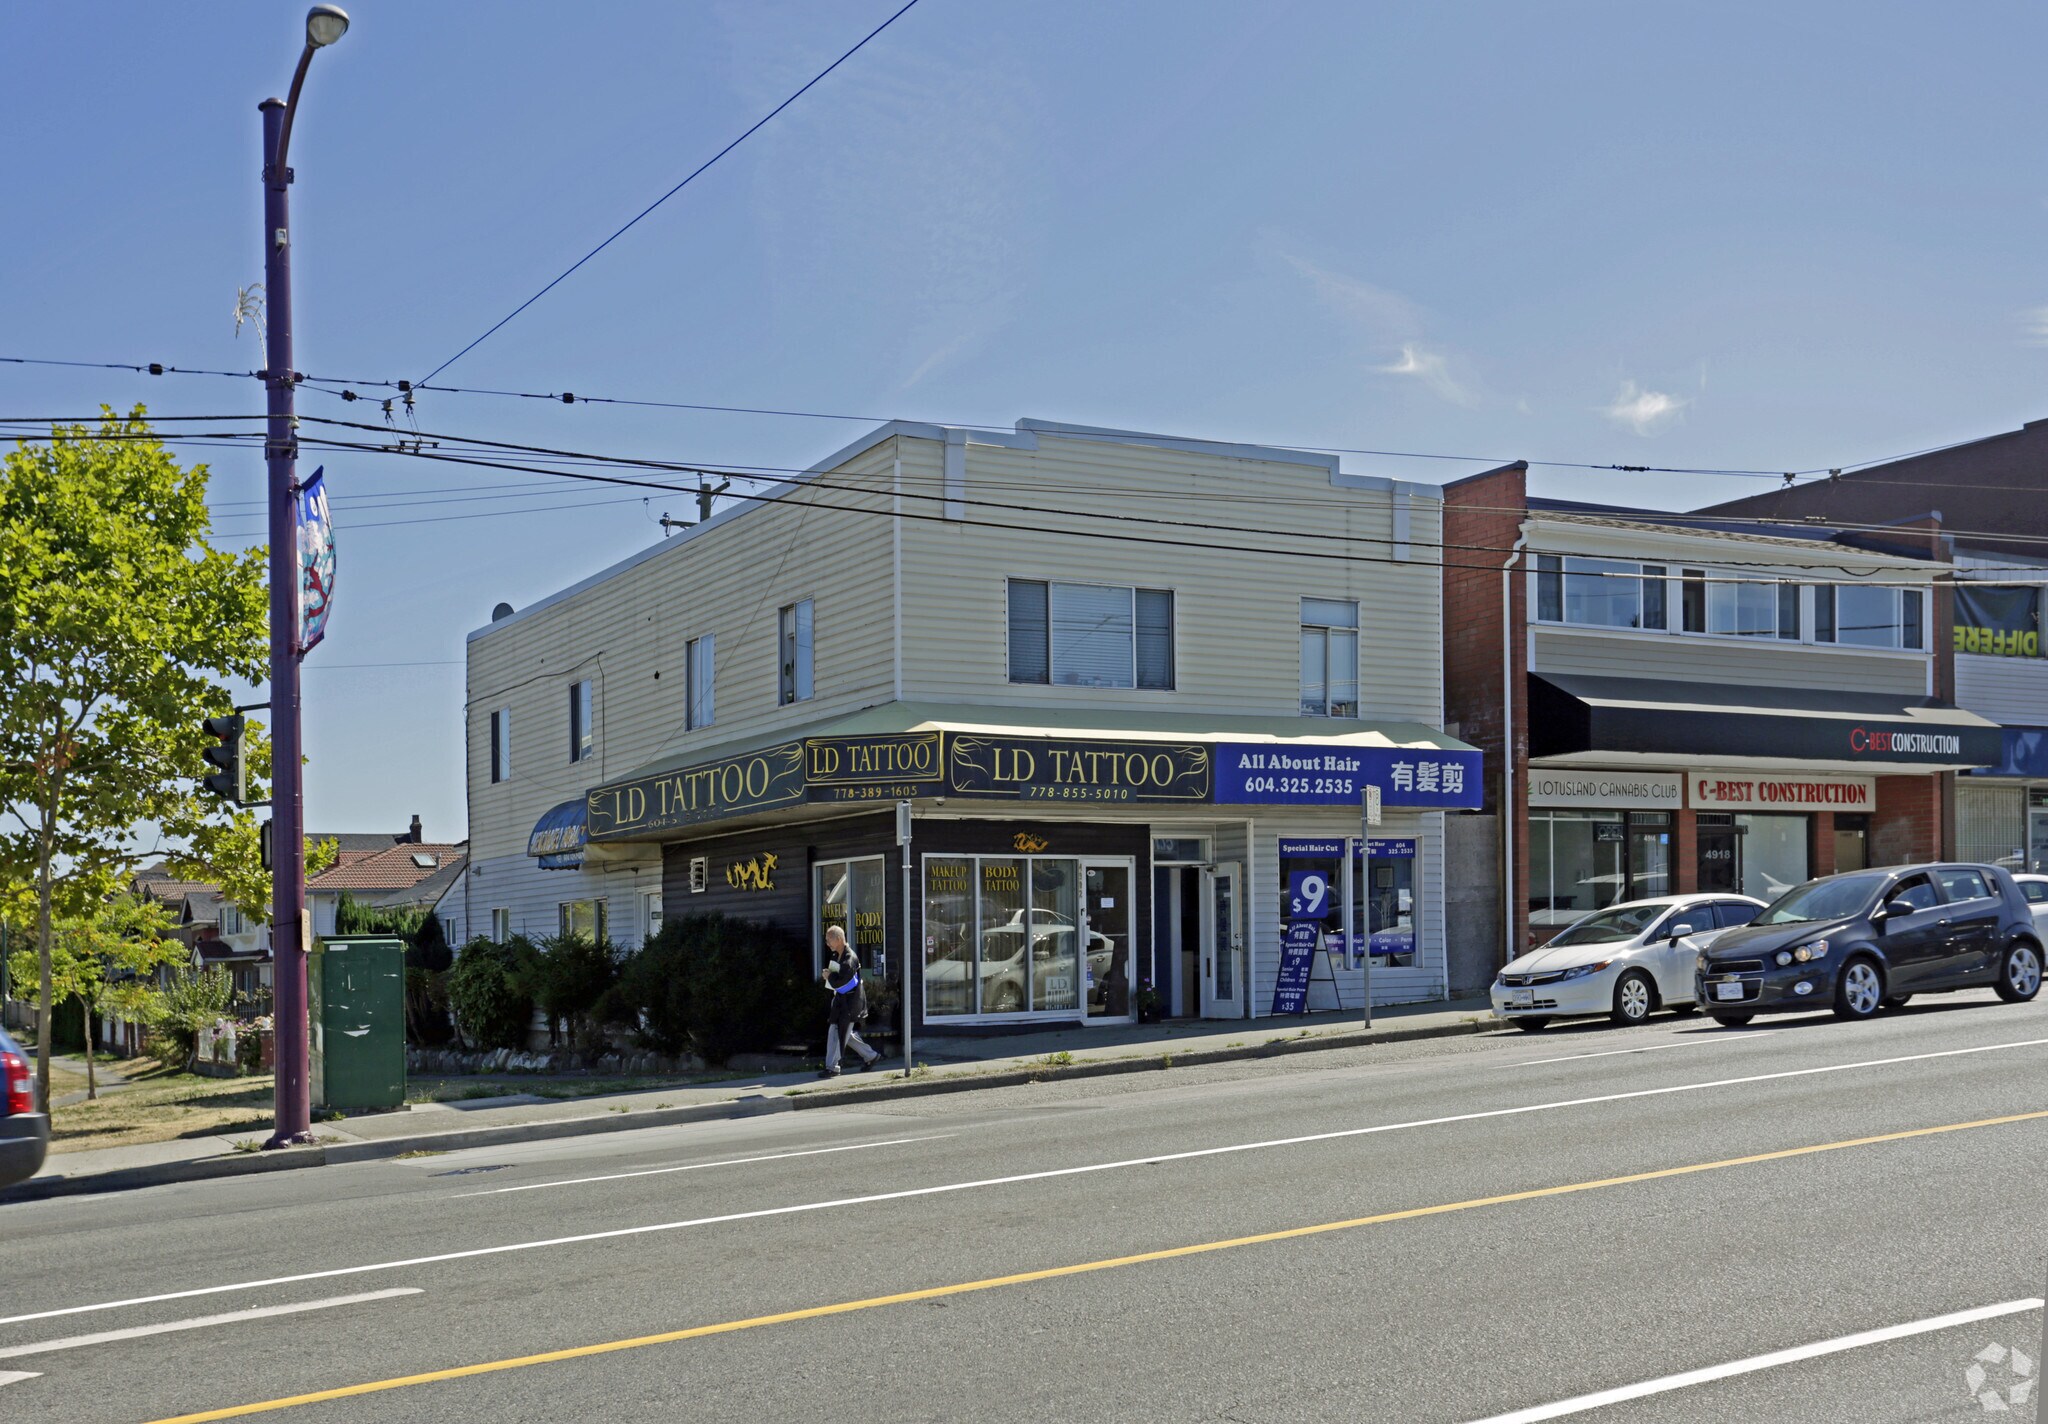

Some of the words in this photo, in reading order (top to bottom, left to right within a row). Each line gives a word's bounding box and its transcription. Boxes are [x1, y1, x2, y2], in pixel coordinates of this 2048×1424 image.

[812, 747, 839, 774] LD
[847, 743, 930, 772] TATTOO
[1238, 753, 1265, 769] All
[1268, 754, 1321, 770] About
[1324, 756, 1360, 771] Hair
[993, 748, 1035, 782] LD
[1048, 749, 1174, 787] TATTOO
[1391, 760, 1464, 793] 有髮剪
[615, 787, 646, 824] LD
[655, 758, 769, 816] TATTOO
[1245, 777, 1352, 793] 604.325.2535
[1538, 781, 1596, 797] LOTUSLAND
[1599, 782, 1649, 798] CANNABIS
[1651, 784, 1678, 799] CLUB
[834, 786, 918, 799] 778-389-1605
[1030, 787, 1128, 799] 778-855-5010
[1758, 782, 1867, 803] CONSTRUCTION
[1282, 844, 1308, 853] Special
[1705, 850, 1731, 859] 4918
[931, 865, 966, 877] MAKEUP
[985, 866, 1018, 878] BODY
[931, 879, 967, 891] TATTOO
[985, 879, 1019, 891] TATTOO
[855, 911, 883, 927] BODY
[856, 929, 883, 944] TATTOO
[1050, 979, 1067, 989] LD
[1282, 1002, 1294, 1011] $35
